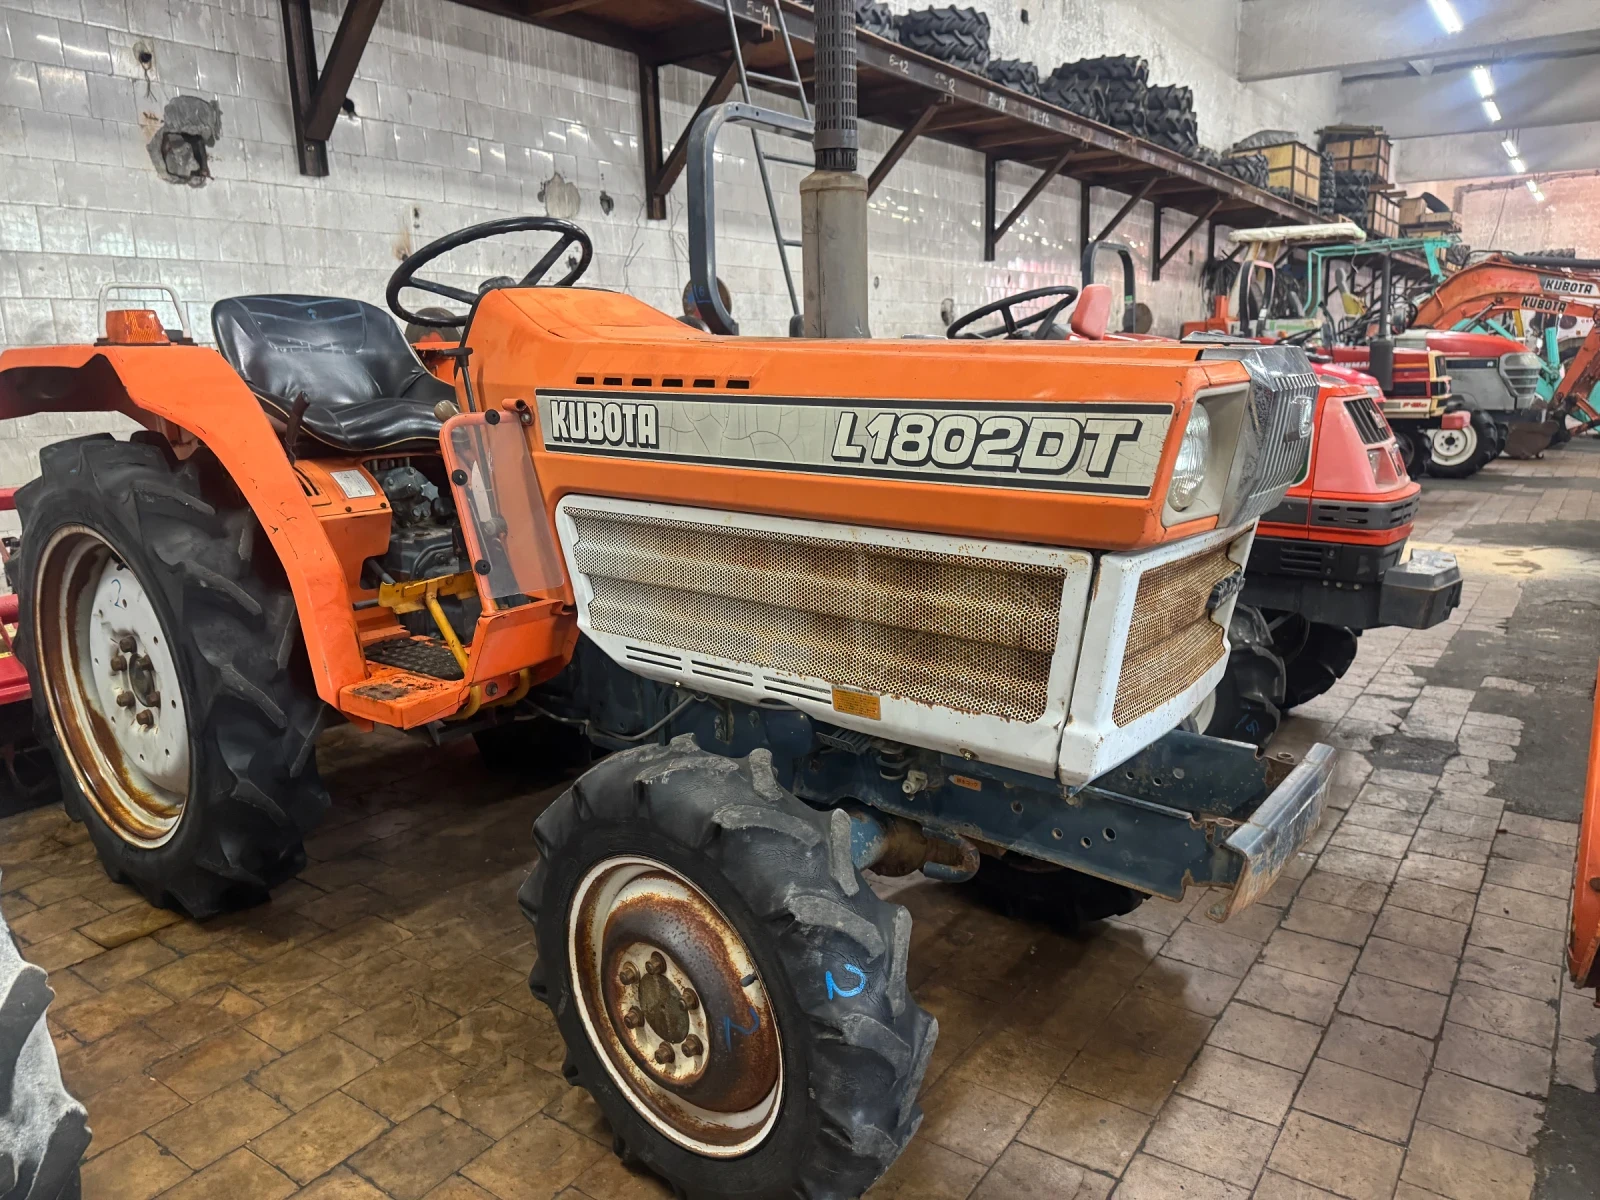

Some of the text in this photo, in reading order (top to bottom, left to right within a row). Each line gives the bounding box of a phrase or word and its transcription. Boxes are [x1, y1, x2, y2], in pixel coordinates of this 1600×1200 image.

[889, 54, 909, 74] 6-12
[1544, 278, 1593, 294] KUBOTA
[1521, 296, 1567, 313] KUBOTA
[550, 400, 1143, 478] KUBOTA L1802DT
